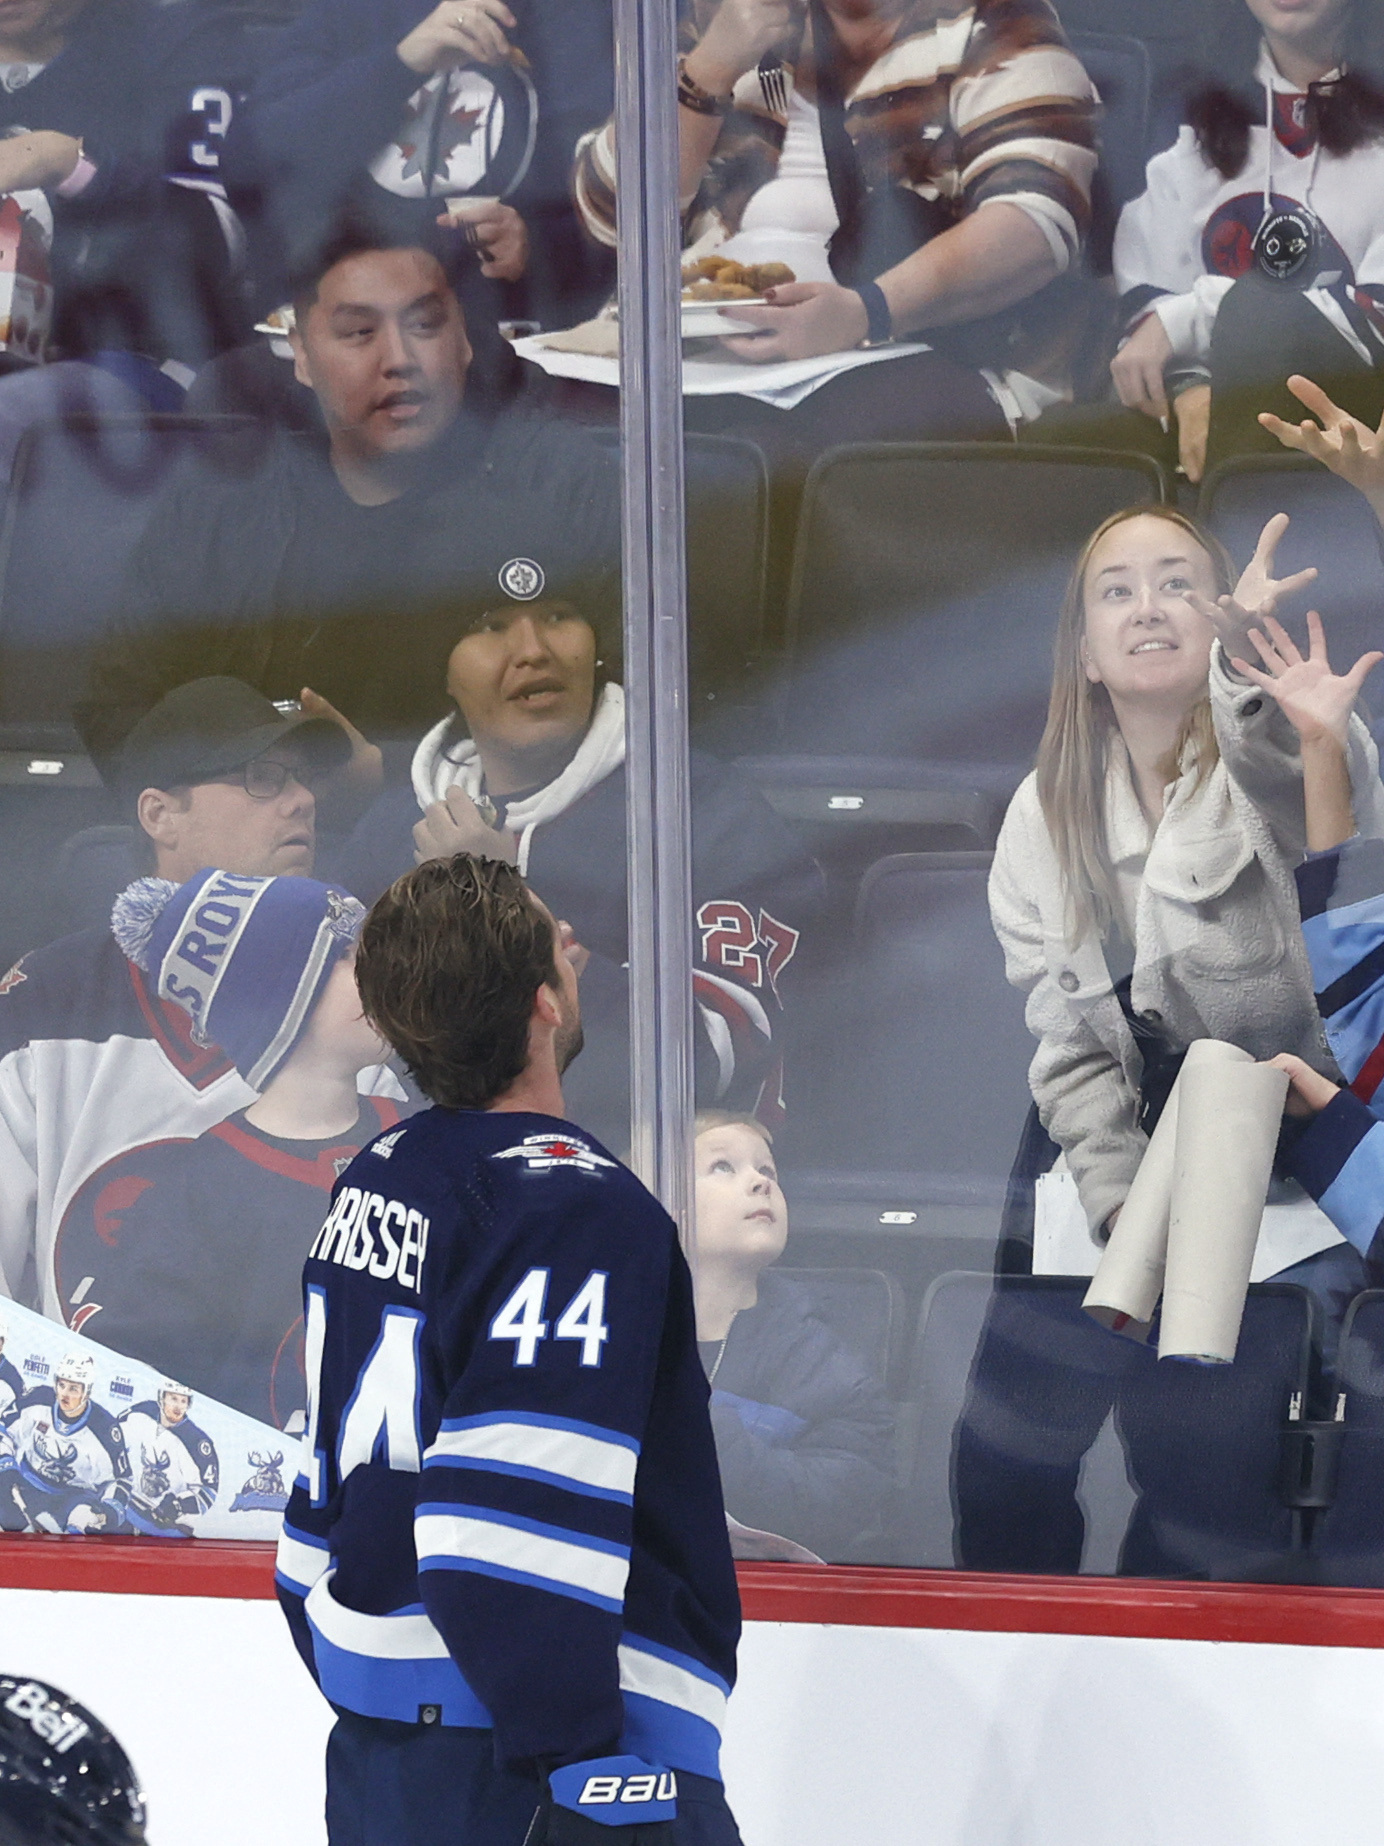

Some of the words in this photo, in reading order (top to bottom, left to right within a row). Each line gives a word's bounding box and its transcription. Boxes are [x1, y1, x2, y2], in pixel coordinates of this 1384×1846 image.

[696, 900, 800, 988] 27
[487, 1266, 610, 1368] 44
[4, 1682, 89, 1754] Bell
